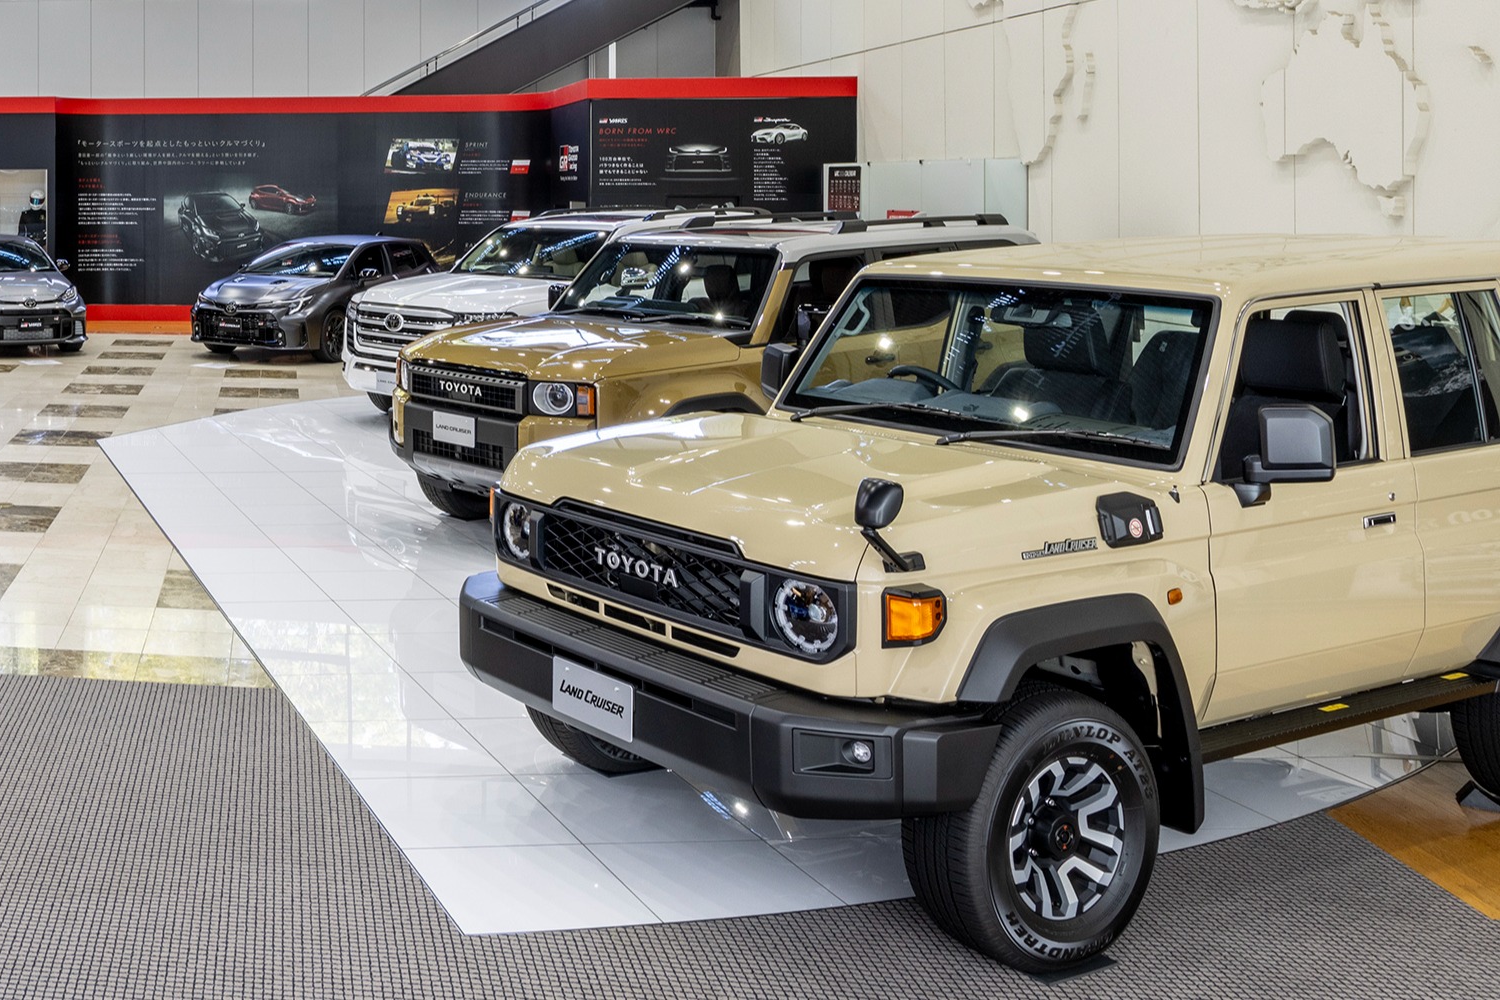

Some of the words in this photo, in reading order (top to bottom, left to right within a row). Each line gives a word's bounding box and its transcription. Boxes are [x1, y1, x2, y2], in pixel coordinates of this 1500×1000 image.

[439, 380, 482, 397] TOYOTA
[436, 423, 449, 431] LAND
[449, 425, 472, 435] CRUISER
[1044, 541, 1066, 555] LAND
[1065, 538, 1098, 552] CRUISER
[594, 546, 678, 588] TOYOTA
[559, 679, 584, 700] LAND
[584, 689, 625, 719] CRUISER
[1041, 724, 1122, 755] DUNLOP
